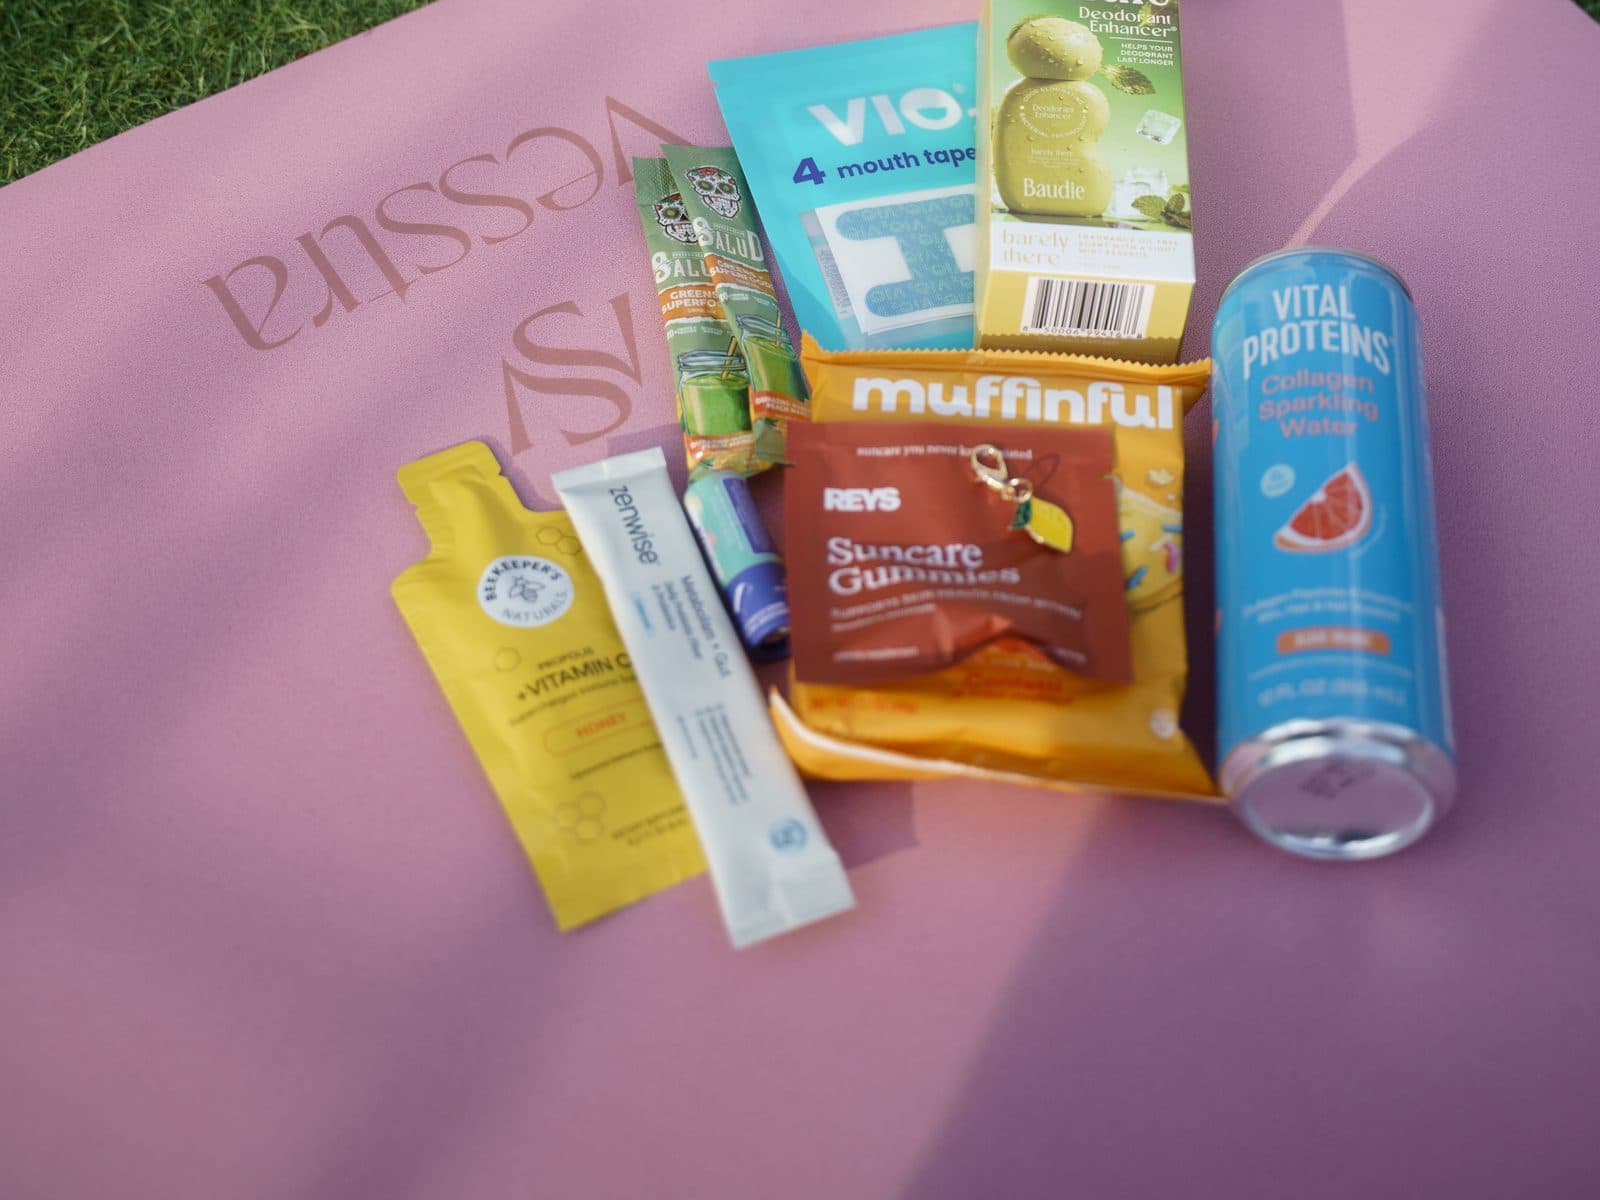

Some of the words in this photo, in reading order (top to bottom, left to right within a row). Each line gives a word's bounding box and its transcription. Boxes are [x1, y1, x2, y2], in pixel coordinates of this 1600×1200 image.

[1078, 6, 1171, 25] Deodorant
[1117, 56, 1138, 64] LAST
[1139, 57, 1174, 66] LONGER
[1120, 50, 1174, 60] DEODORANT
[1121, 43, 1148, 51] HELPS
[1149, 44, 1173, 53] YOUR
[807, 86, 977, 147] VIO
[792, 156, 826, 186] 4
[836, 151, 921, 179] mouth
[1023, 177, 1086, 200] Baudie
[200, 94, 697, 352] Vesstra
[1002, 229, 1070, 254] barely
[1003, 248, 1062, 266] there
[661, 298, 720, 315] SUPERFO
[1271, 282, 1357, 322] VITAL
[1242, 318, 1392, 382] PROTEINS
[1260, 367, 1375, 396] Collagen
[852, 374, 1175, 430] muffinful
[1257, 391, 1380, 422] Sparkling
[1279, 415, 1359, 440] Water
[903, 444, 925, 457] you
[823, 486, 902, 513] REYS
[610, 484, 660, 566] zenwise
[826, 536, 984, 569] Suncare
[484, 559, 564, 602] BEEKEEPER'S
[828, 564, 1021, 596] Gummies
[576, 711, 628, 738] HONEY
